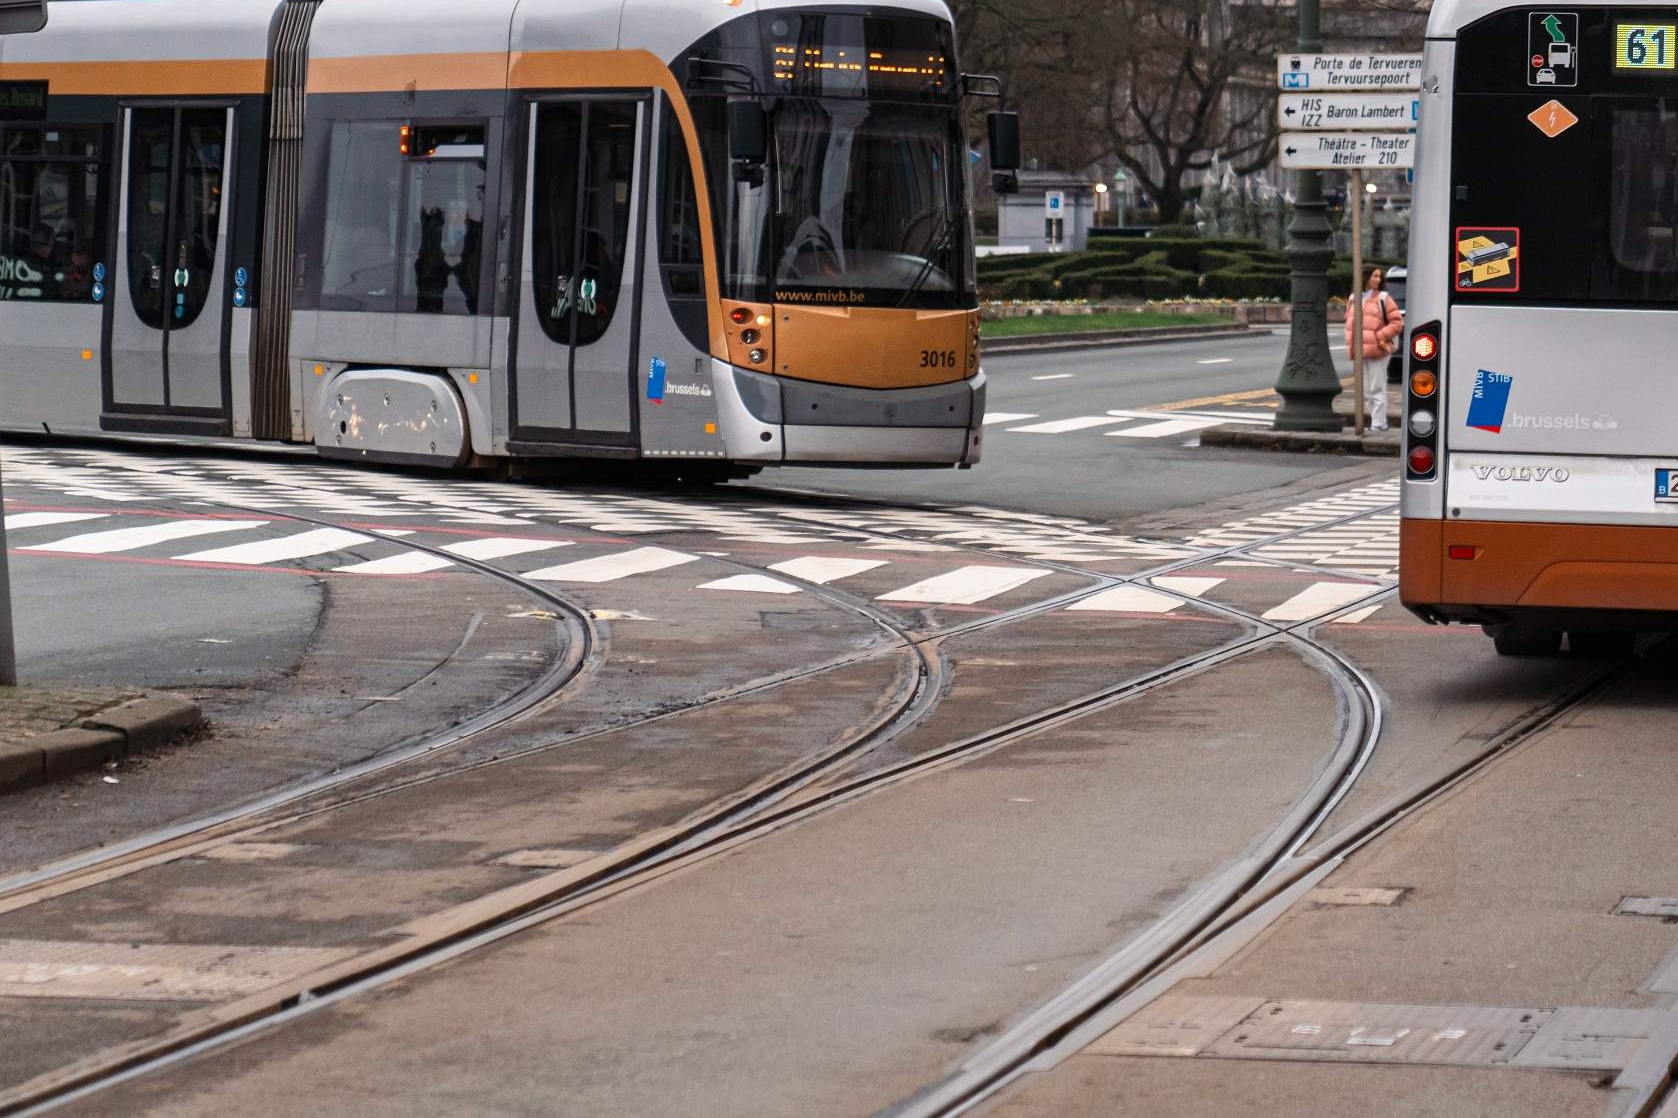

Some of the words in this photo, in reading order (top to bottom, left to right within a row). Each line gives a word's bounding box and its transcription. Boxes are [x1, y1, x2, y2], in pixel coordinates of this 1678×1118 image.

[1625, 29, 1667, 66] 61
[1313, 56, 1344, 71] Porte
[1349, 56, 1363, 70] de
[1367, 56, 1423, 70] Tervueren
[1326, 71, 1410, 89] Tervuursepoort
[1301, 98, 1323, 112] HIS
[1326, 105, 1358, 119] Baron
[1360, 105, 1405, 119] Lambert
[1301, 114, 1323, 127] IZZ
[1370, 136, 1410, 150] Theater
[1331, 152, 1366, 165] Atelier
[1378, 151, 1398, 165] 210
[775, 290, 865, 304] www.mivb.be
[919, 350, 957, 369] 3016
[1474, 370, 1484, 399] MIVB
[1487, 372, 1511, 383] STIB
[664, 381, 700, 396] .brussels
[1507, 412, 1591, 430] .brussels
[1471, 465, 1570, 482] VOLVO
[1658, 485, 1666, 495] B
